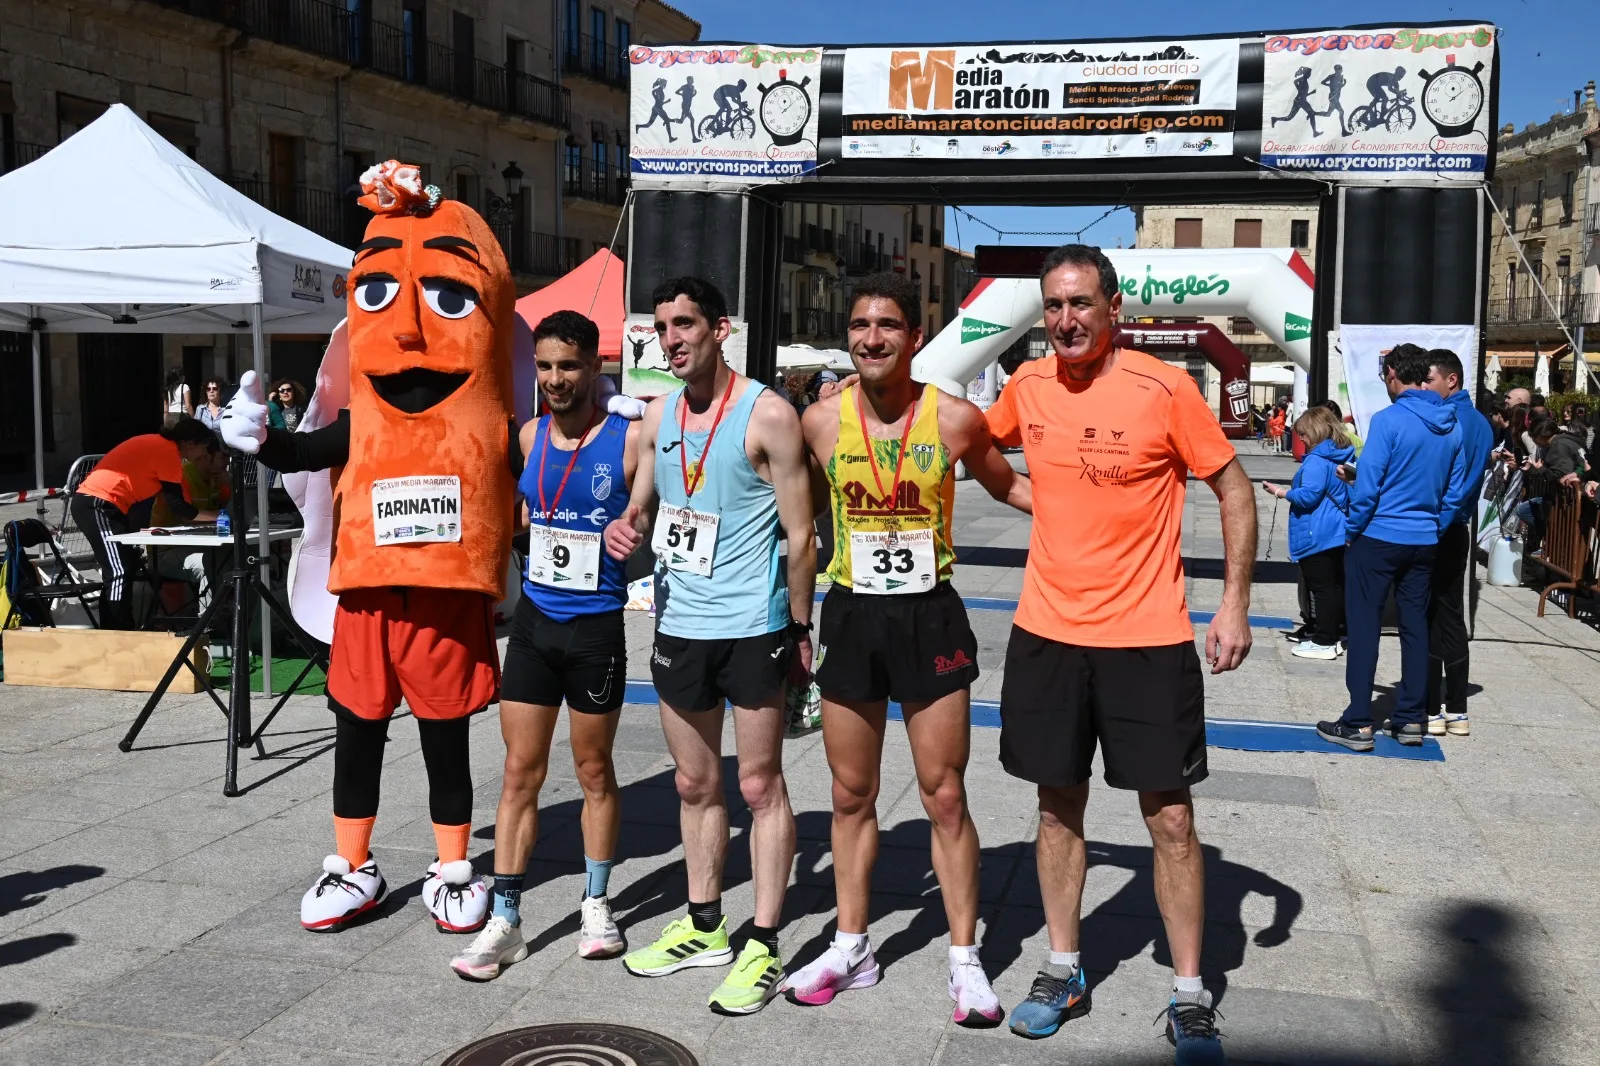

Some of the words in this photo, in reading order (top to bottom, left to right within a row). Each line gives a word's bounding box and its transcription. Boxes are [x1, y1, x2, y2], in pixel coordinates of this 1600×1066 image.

[1083, 64, 1137, 76] ciudad
[1140, 85, 1156, 93] por
[1162, 94, 1195, 103] Rodrigo
[852, 114, 1224, 131] mediamaratonciudadrodrigo.com
[641, 160, 803, 175] www.orycronsport.com
[1276, 154, 1471, 171] www.orycronsport.com
[401, 479, 421, 487] MEDIA
[423, 477, 457, 486] MARATÓN
[377, 495, 457, 519] FARINATÍN
[667, 523, 697, 552] 51
[900, 531, 932, 541] MARATÓN
[553, 545, 570, 568] 9
[873, 549, 915, 574] 33
